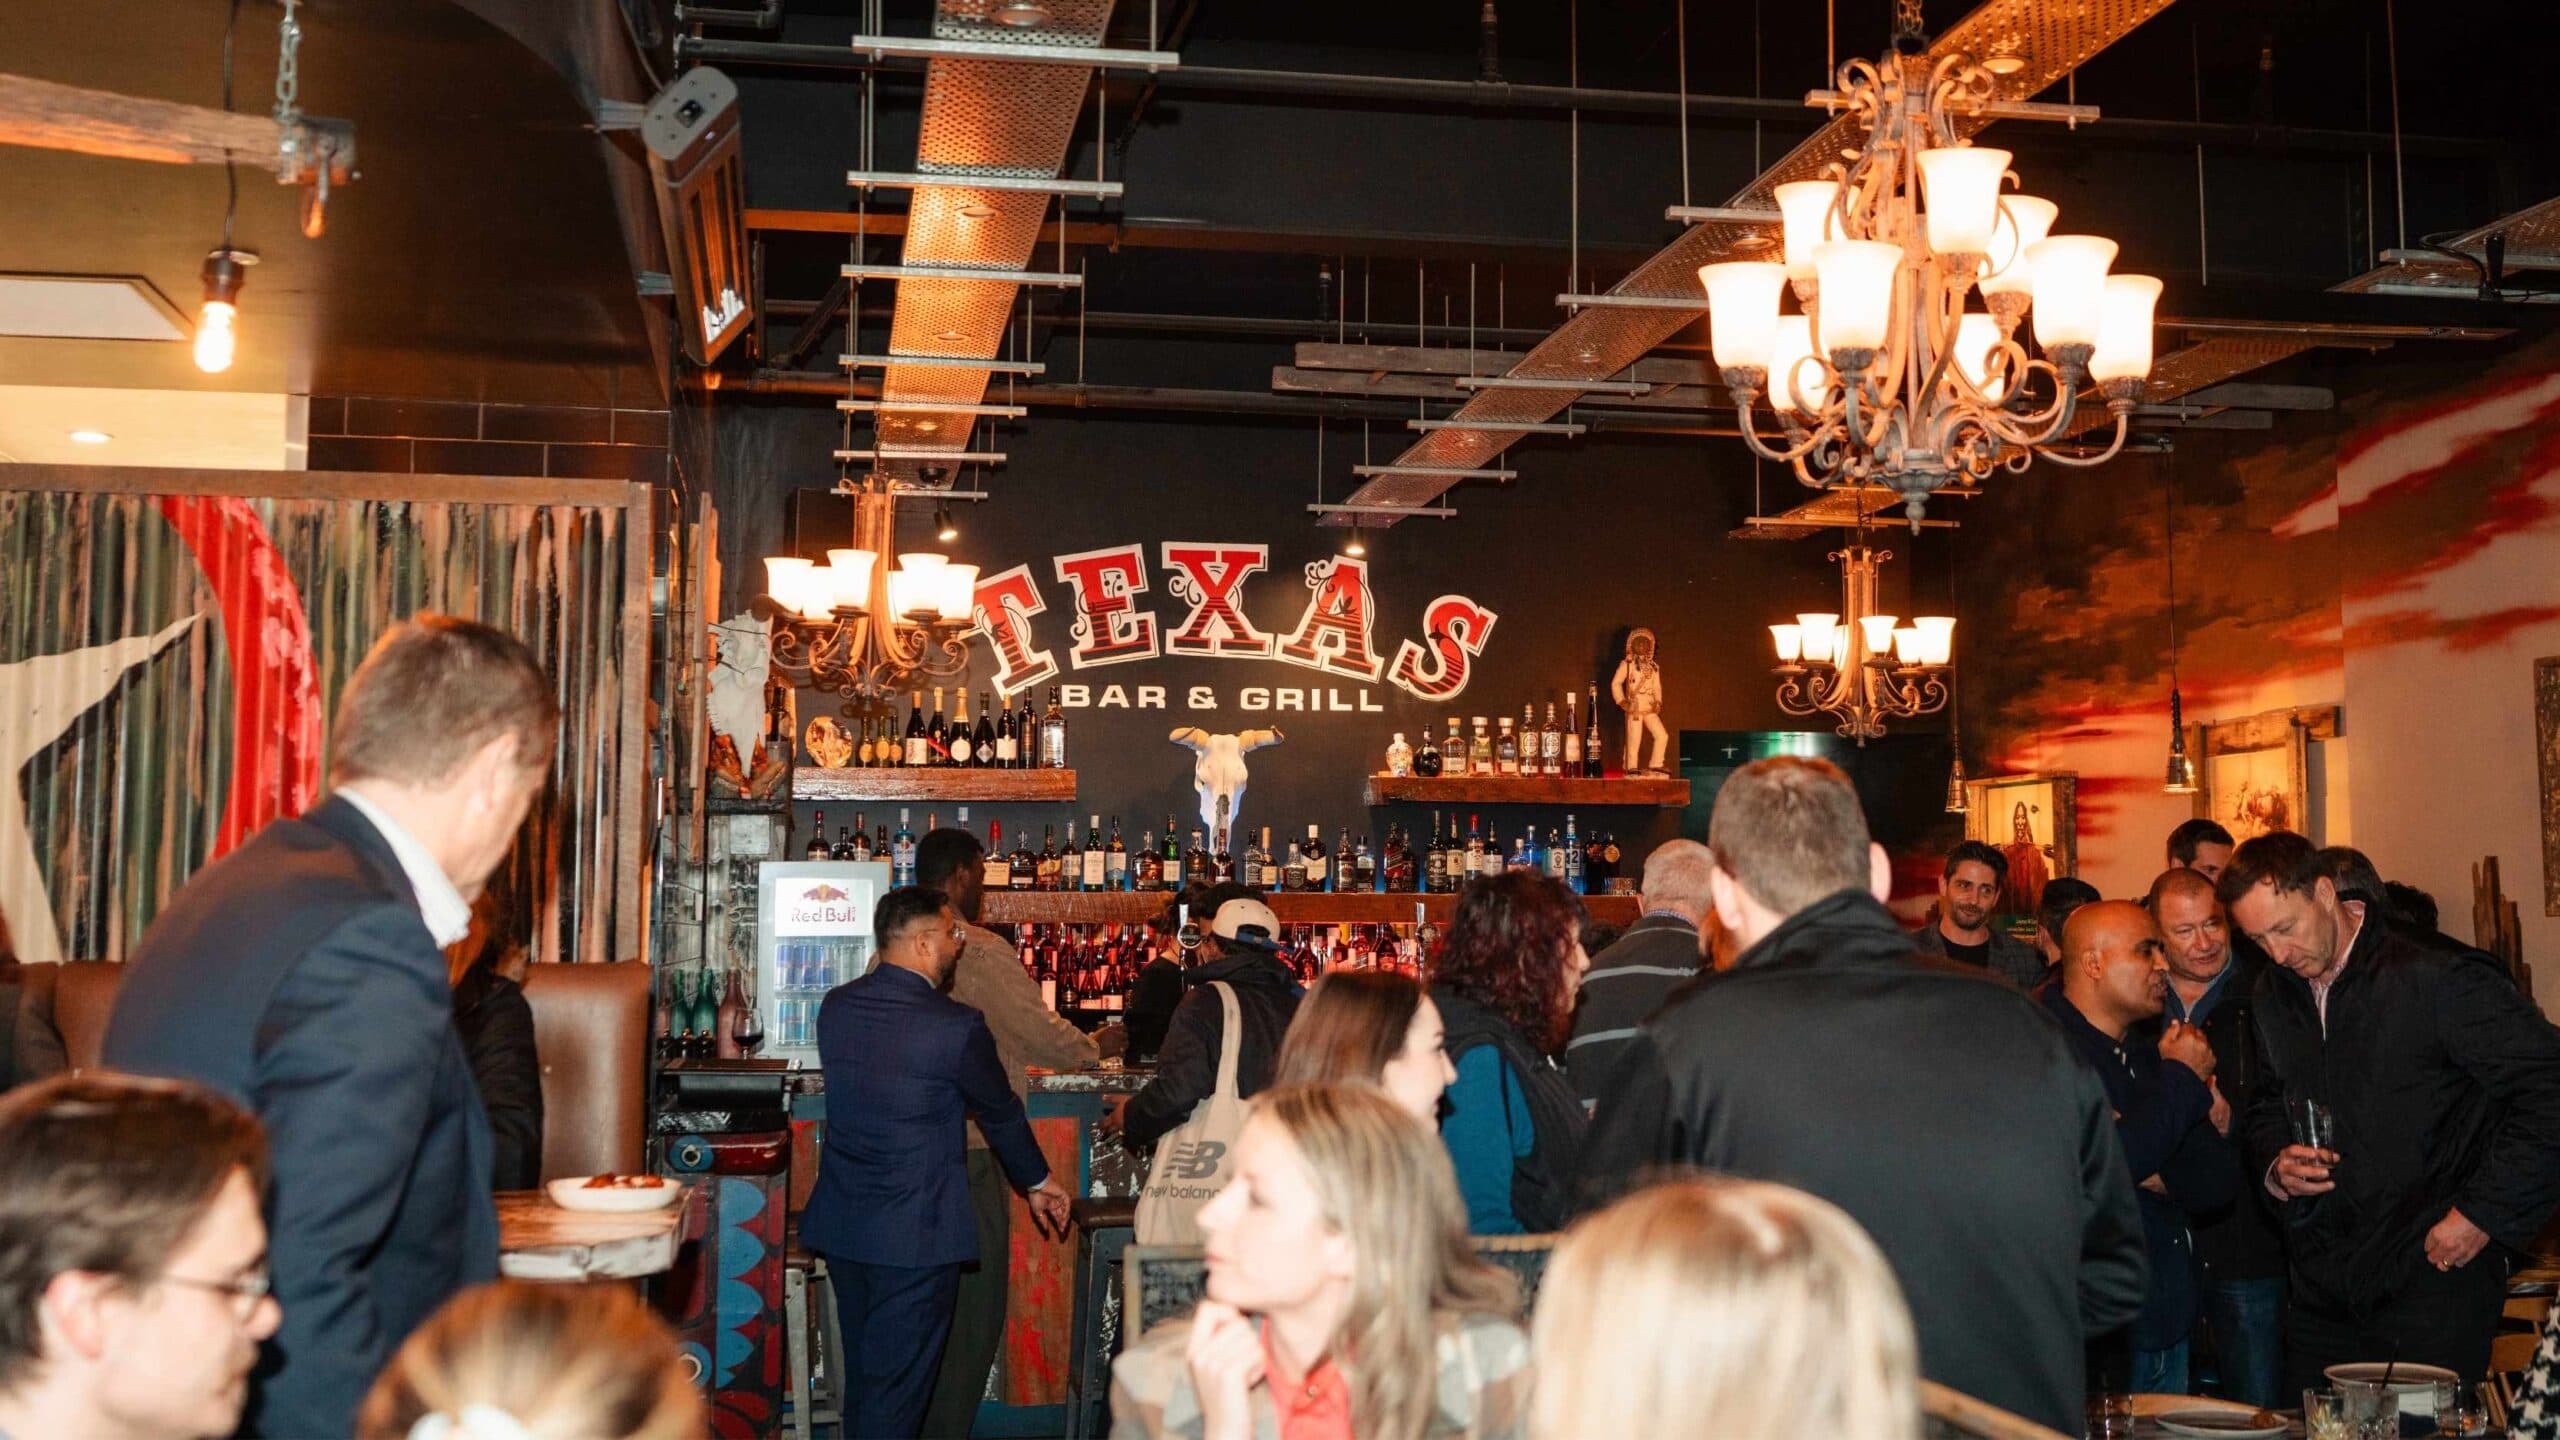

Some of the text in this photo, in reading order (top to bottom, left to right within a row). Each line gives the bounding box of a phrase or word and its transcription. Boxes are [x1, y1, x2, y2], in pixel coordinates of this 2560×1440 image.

[970, 541, 1498, 702] TEXAS
[1061, 684, 1384, 712] BAR & GRILL
[793, 906, 855, 922] Red Bull
[1145, 1182, 1221, 1201] new balanc
